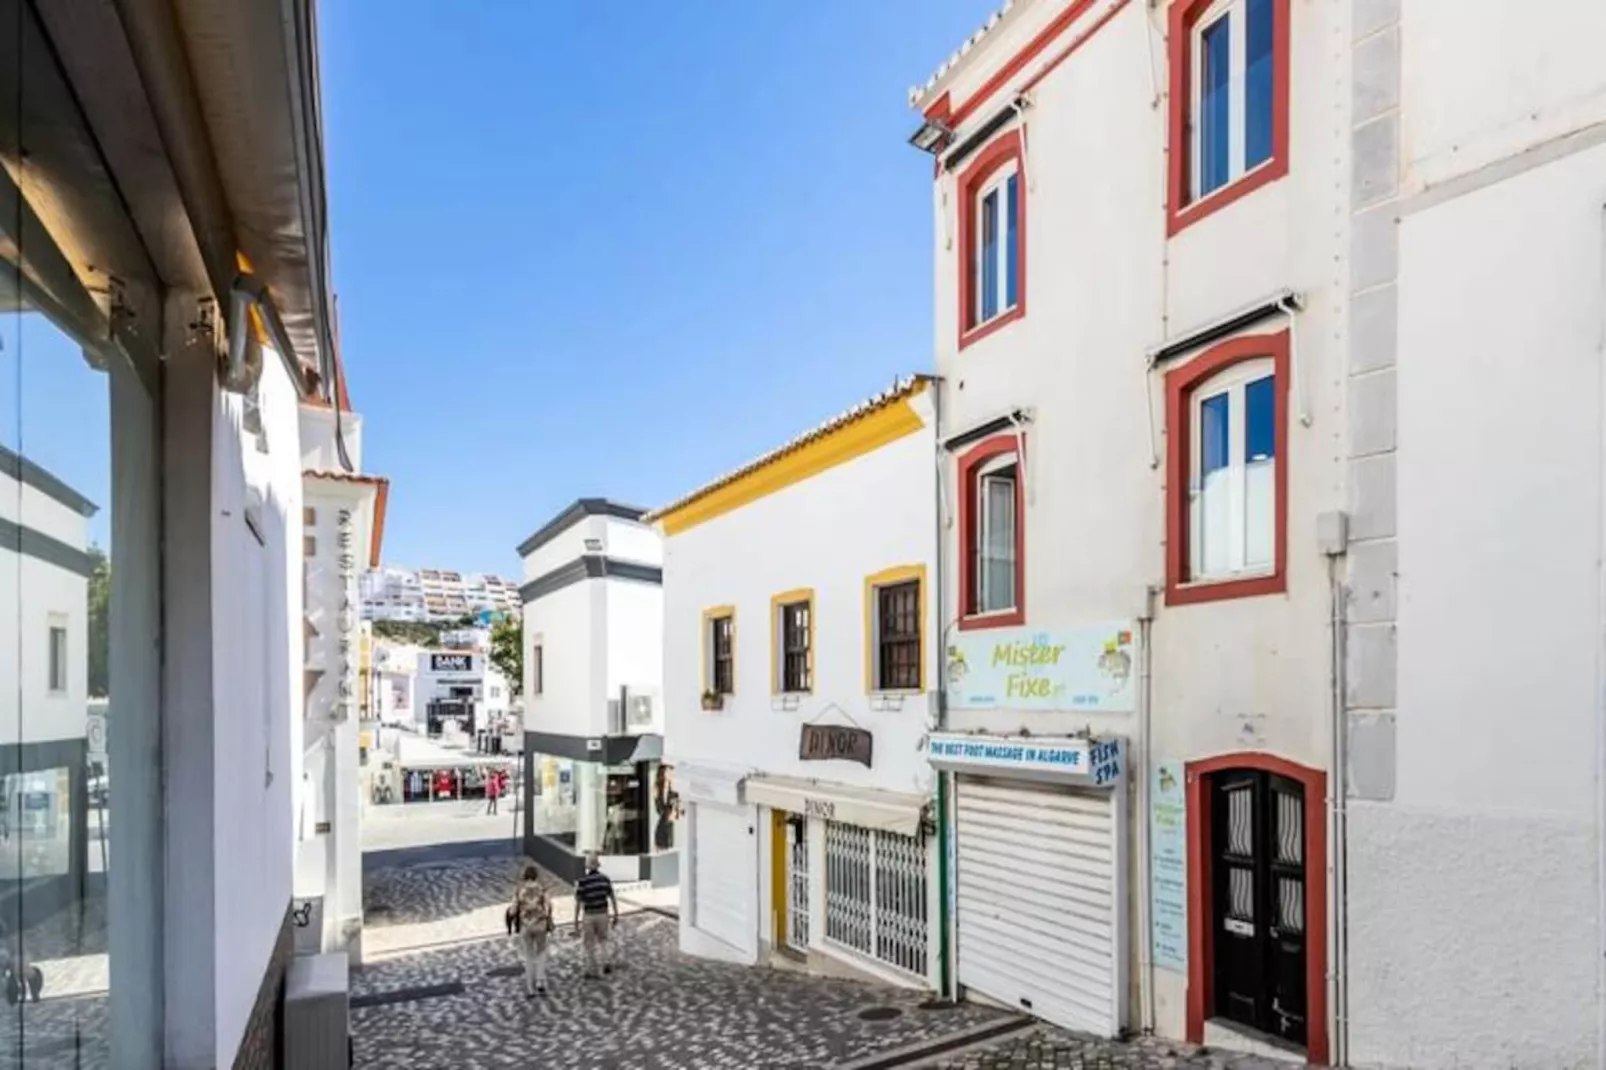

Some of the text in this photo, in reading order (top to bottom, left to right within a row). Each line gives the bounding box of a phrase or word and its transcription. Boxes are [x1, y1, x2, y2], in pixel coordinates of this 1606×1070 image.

[992, 640, 1066, 668] Mister
[1006, 671, 1051, 698] Fixe
[931, 742, 944, 756] THE
[964, 744, 984, 758] FOOT
[985, 746, 1022, 761] MASSAGE
[1025, 748, 1036, 761] IN
[1038, 748, 1080, 765] ALGARVE
[1090, 739, 1119, 766] FISH
[1096, 760, 1120, 785] SPA
